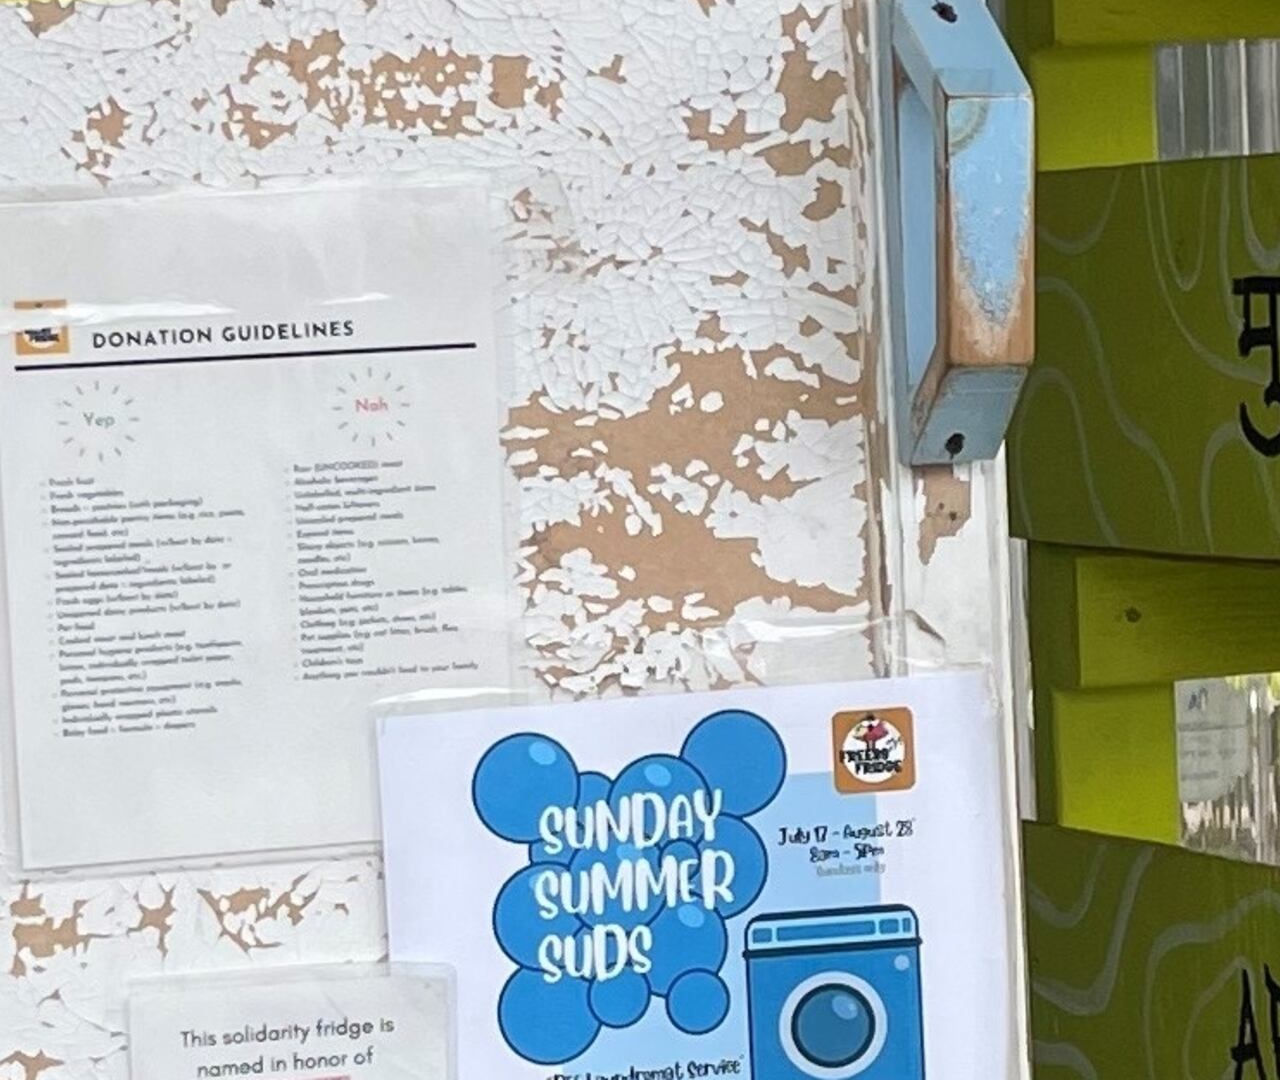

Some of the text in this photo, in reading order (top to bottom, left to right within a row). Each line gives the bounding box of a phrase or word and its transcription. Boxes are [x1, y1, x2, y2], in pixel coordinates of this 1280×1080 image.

[92, 319, 355, 350] DONATION GUIDELINES
[83, 410, 116, 431] Yep
[354, 397, 389, 414] Nah
[538, 788, 723, 855] SUNDAY
[778, 825, 811, 846] July
[814, 825, 828, 843] 17
[842, 820, 894, 841] August
[809, 846, 840, 864] 8am
[534, 849, 736, 920] SUMMER
[537, 923, 652, 984] SUDS
[180, 1016, 396, 1049] This solidarity fridge is
[197, 1045, 376, 1079] named in honor of
